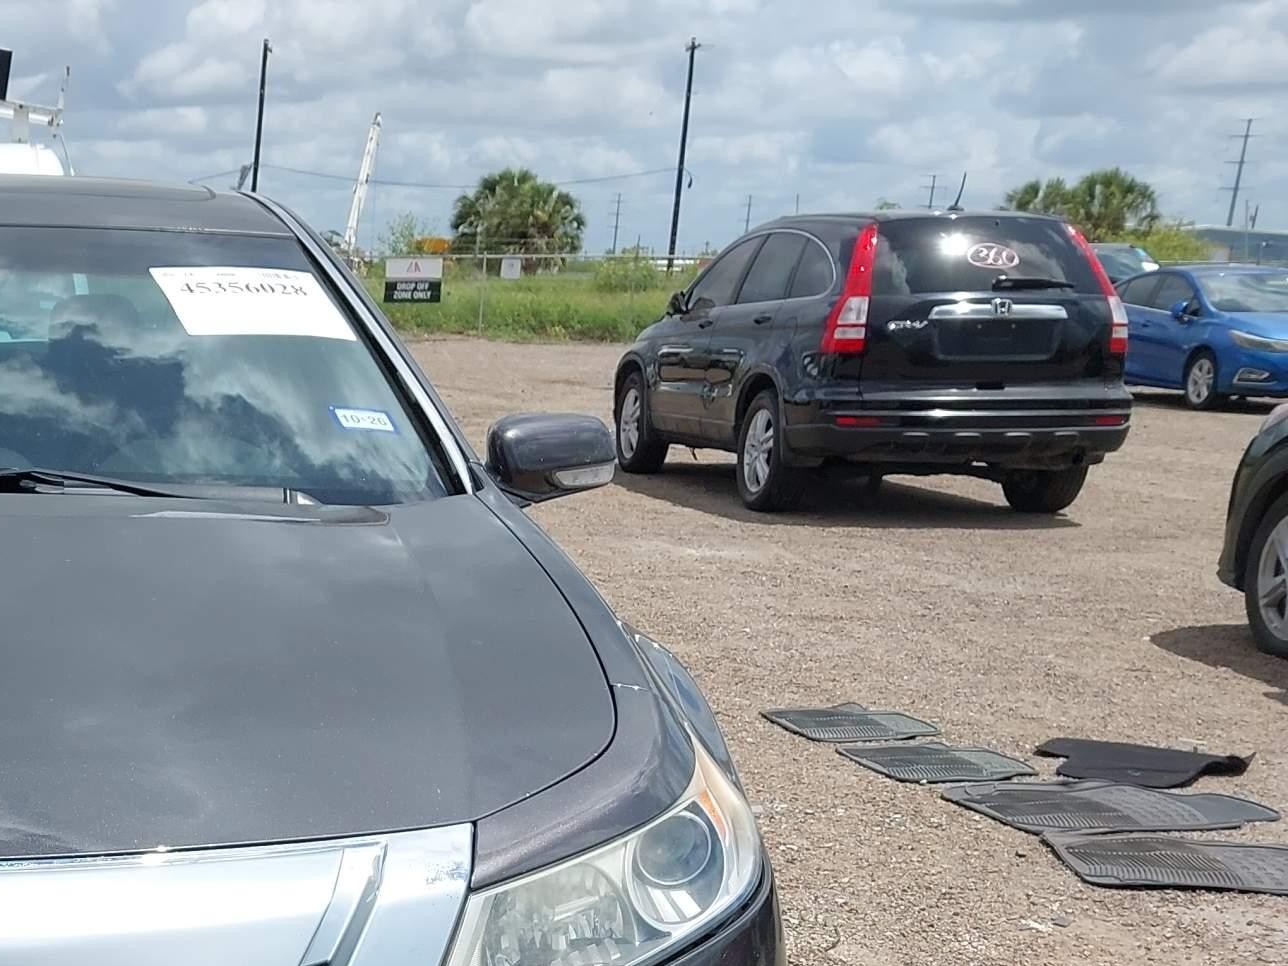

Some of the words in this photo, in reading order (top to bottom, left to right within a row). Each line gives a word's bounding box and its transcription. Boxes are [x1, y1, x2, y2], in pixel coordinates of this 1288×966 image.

[179, 281, 308, 297] 45356028
[396, 282, 416, 290] DROP
[416, 282, 430, 290] OFF
[393, 290, 412, 299] ZONE
[413, 290, 432, 299] ONLY
